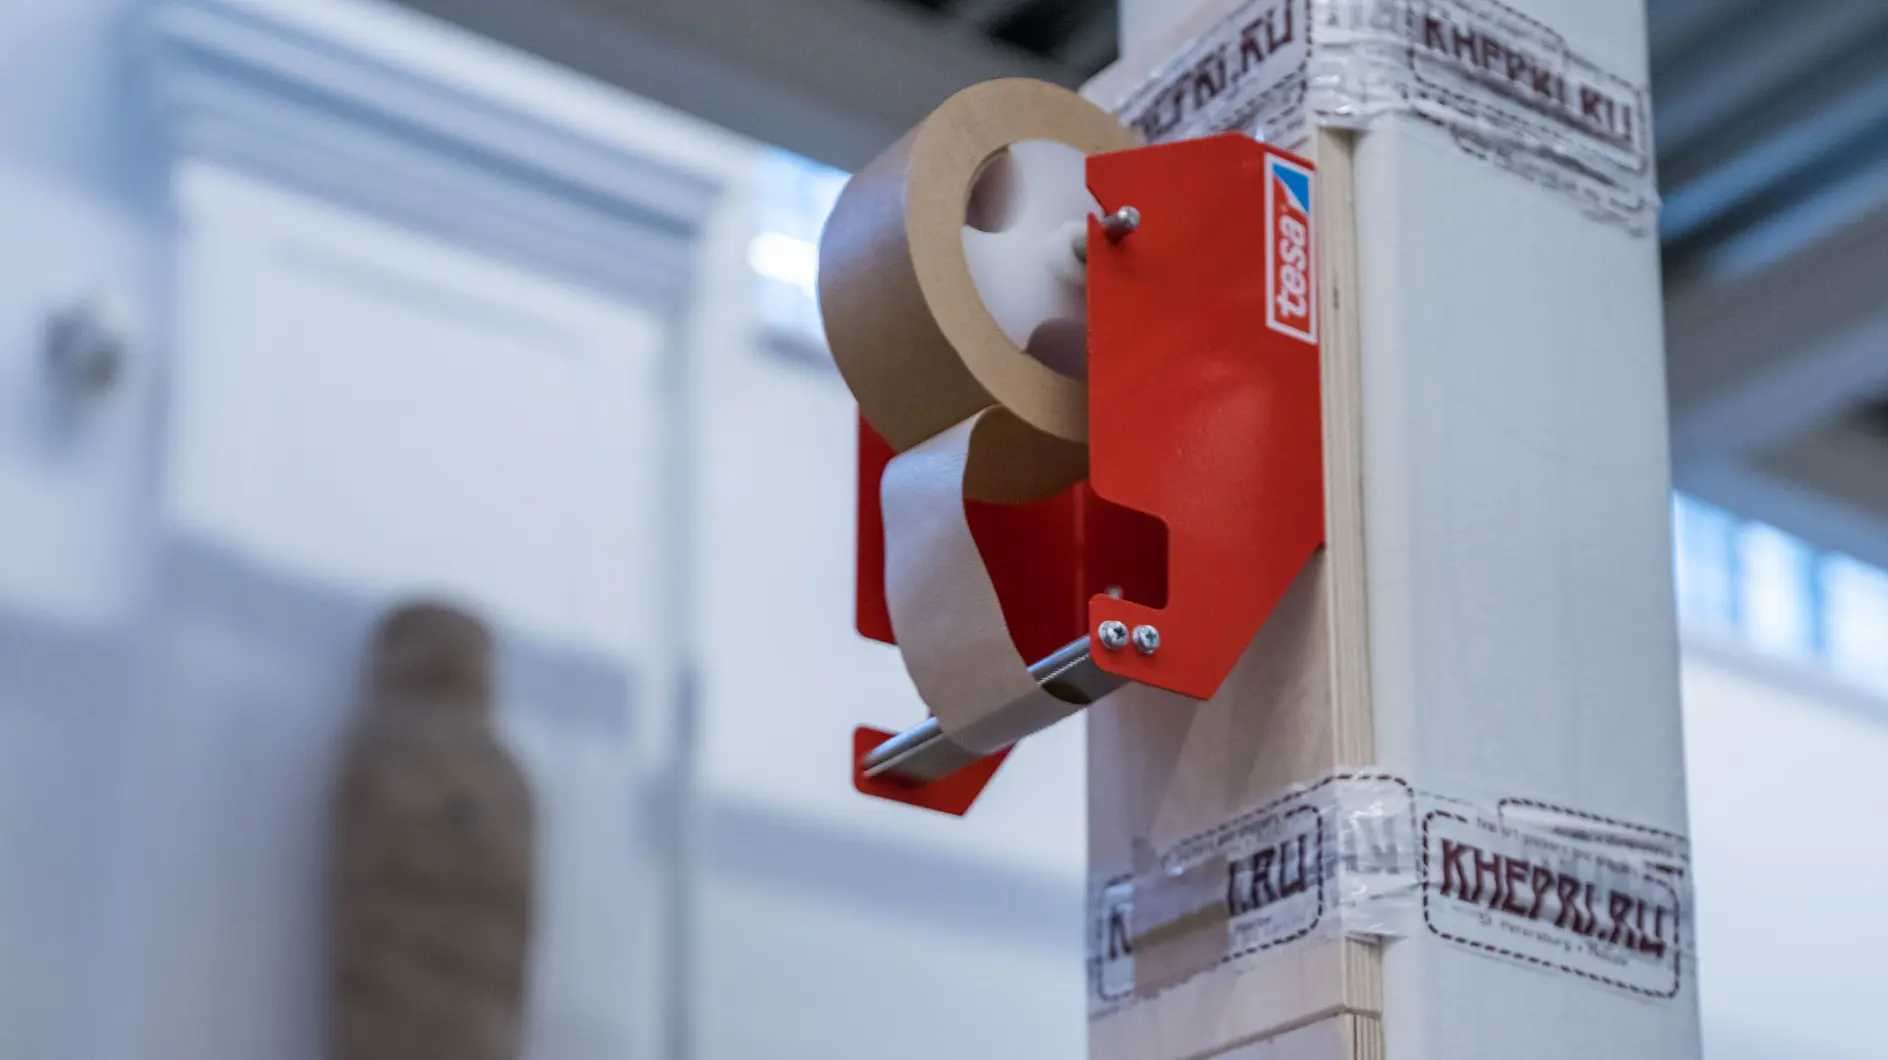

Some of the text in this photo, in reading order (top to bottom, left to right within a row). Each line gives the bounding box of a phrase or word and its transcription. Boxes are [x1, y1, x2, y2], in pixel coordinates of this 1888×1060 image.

[1424, 15, 1634, 152] KHEPRIRU
[1277, 214, 1307, 318] tesa
[1440, 838, 1667, 958] KHEPRI.RU
